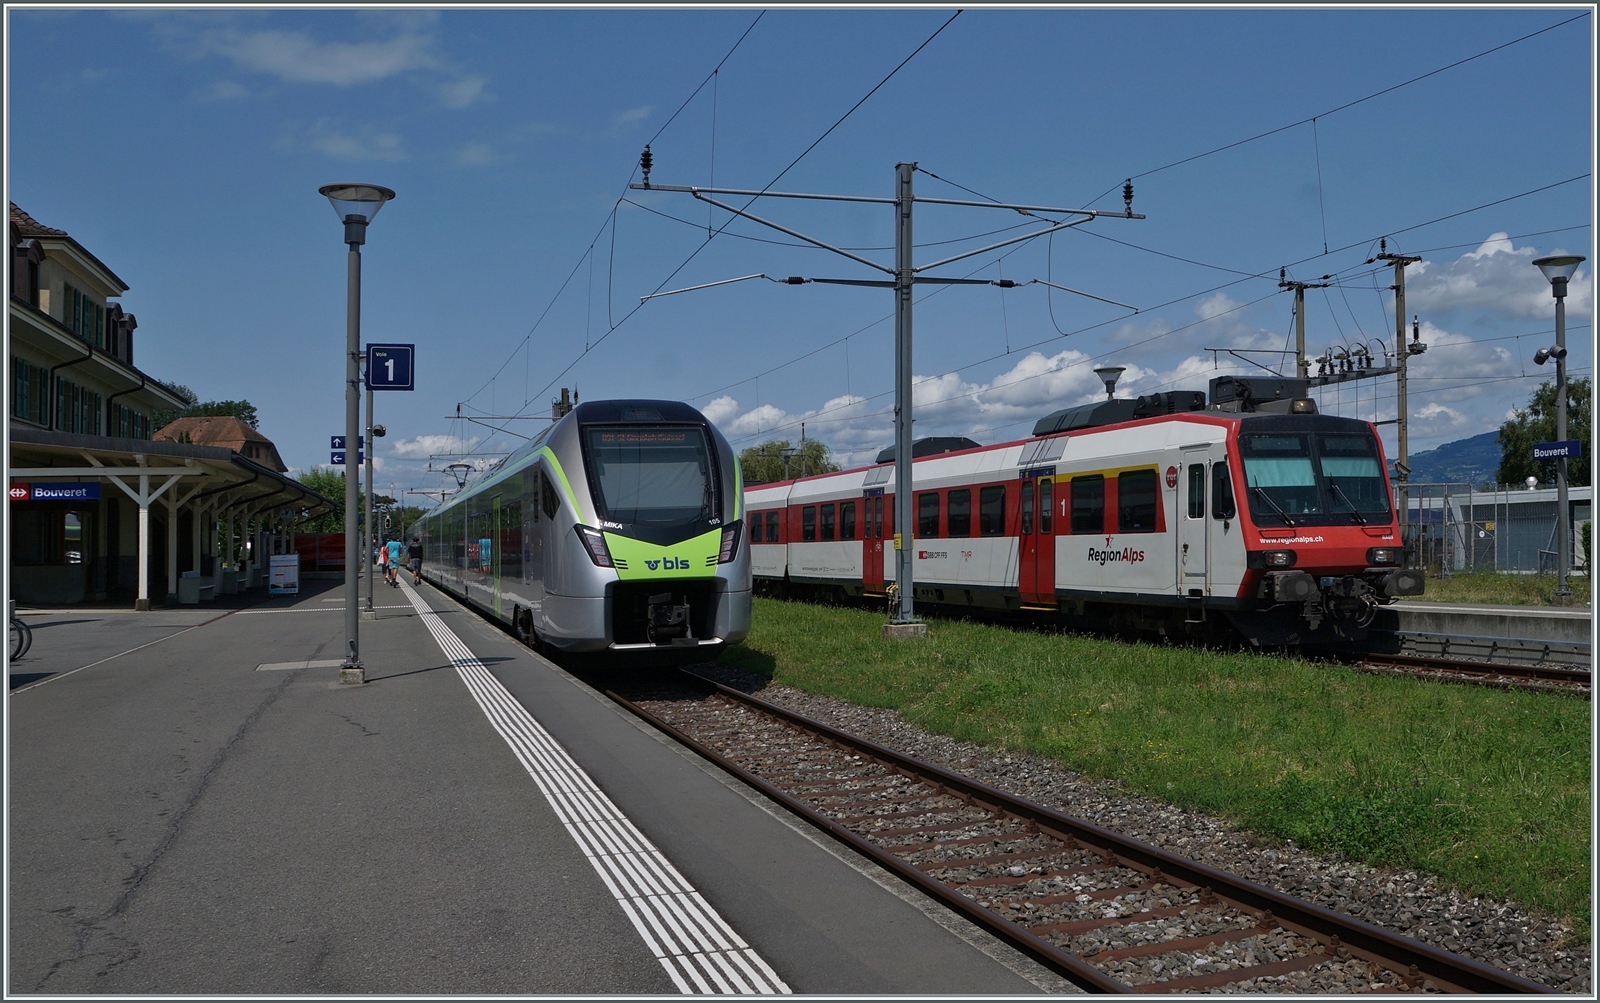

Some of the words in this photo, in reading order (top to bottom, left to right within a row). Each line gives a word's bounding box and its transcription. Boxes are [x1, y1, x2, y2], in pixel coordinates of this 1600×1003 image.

[384, 358, 394, 381] 1
[1533, 446, 1569, 458] Bouveret
[34, 487, 87, 497] Bouveret
[1060, 498, 1066, 517] 1
[603, 520, 623, 530] MIKA
[708, 517, 721, 525] 105
[1259, 535, 1324, 545] www.regionalps.ch
[1087, 547, 1145, 566] RegionAlps
[663, 556, 690, 570] bls
